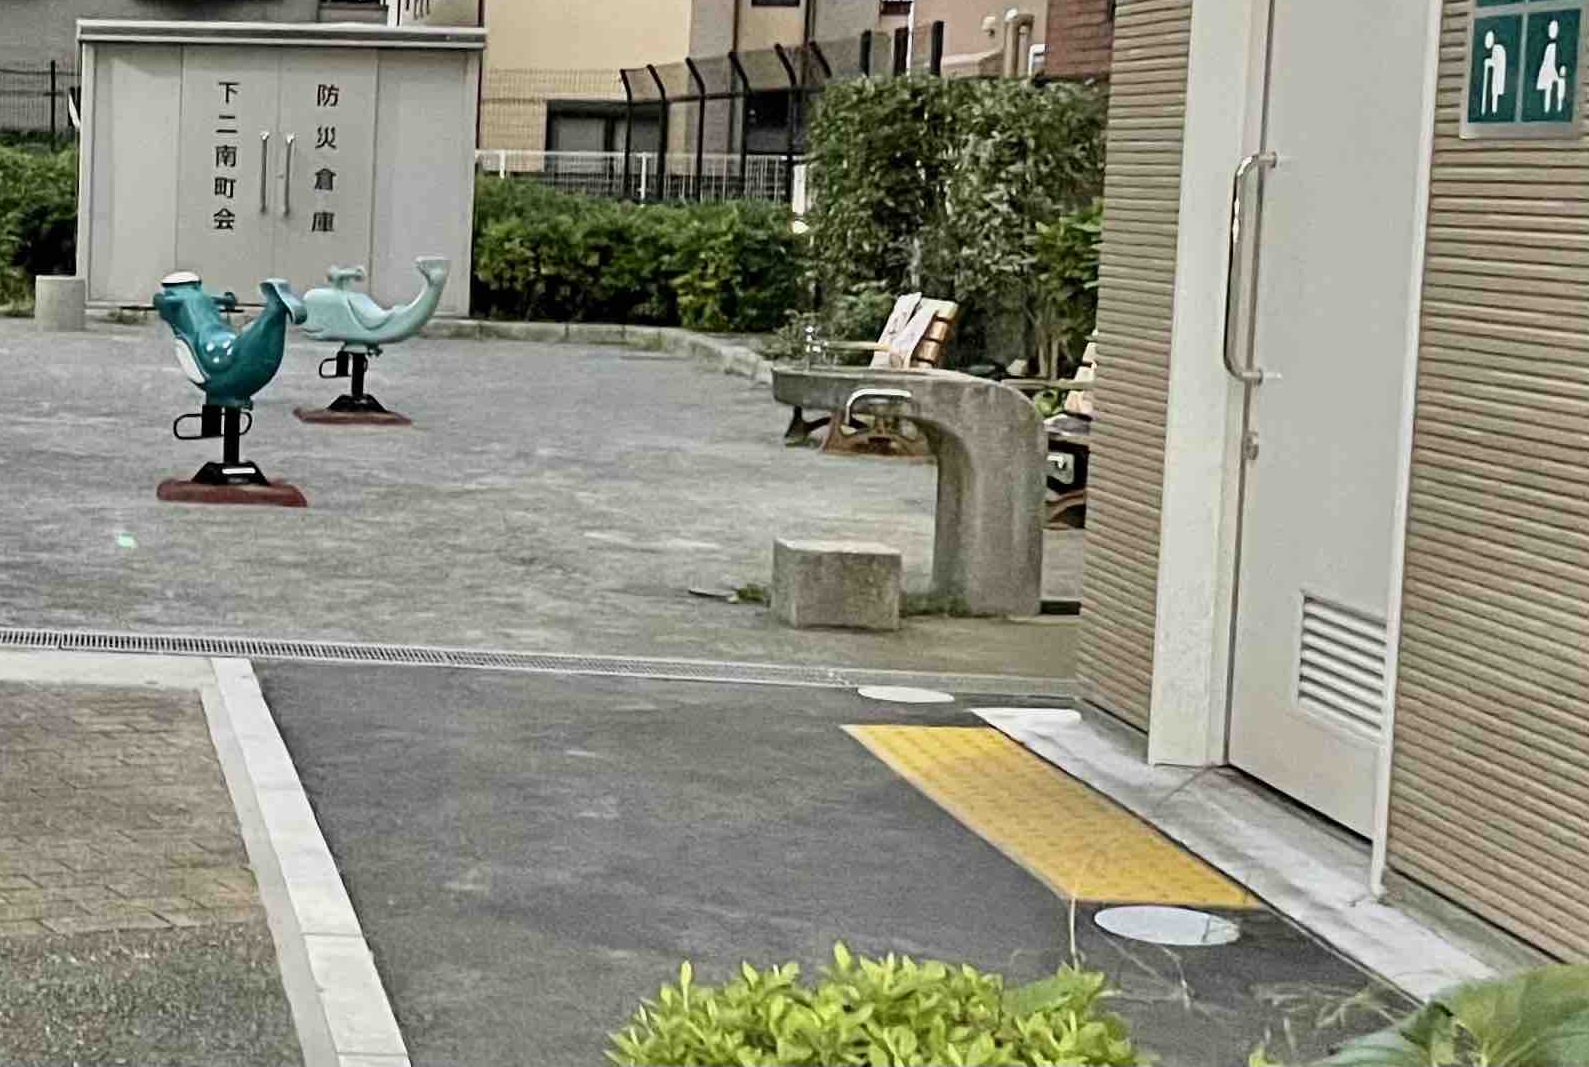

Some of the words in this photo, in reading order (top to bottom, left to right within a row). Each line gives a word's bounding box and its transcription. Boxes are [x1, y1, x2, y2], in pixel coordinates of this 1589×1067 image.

[213, 81, 239, 231] 下二南町会
[312, 83, 340, 233] 防災倉庫
